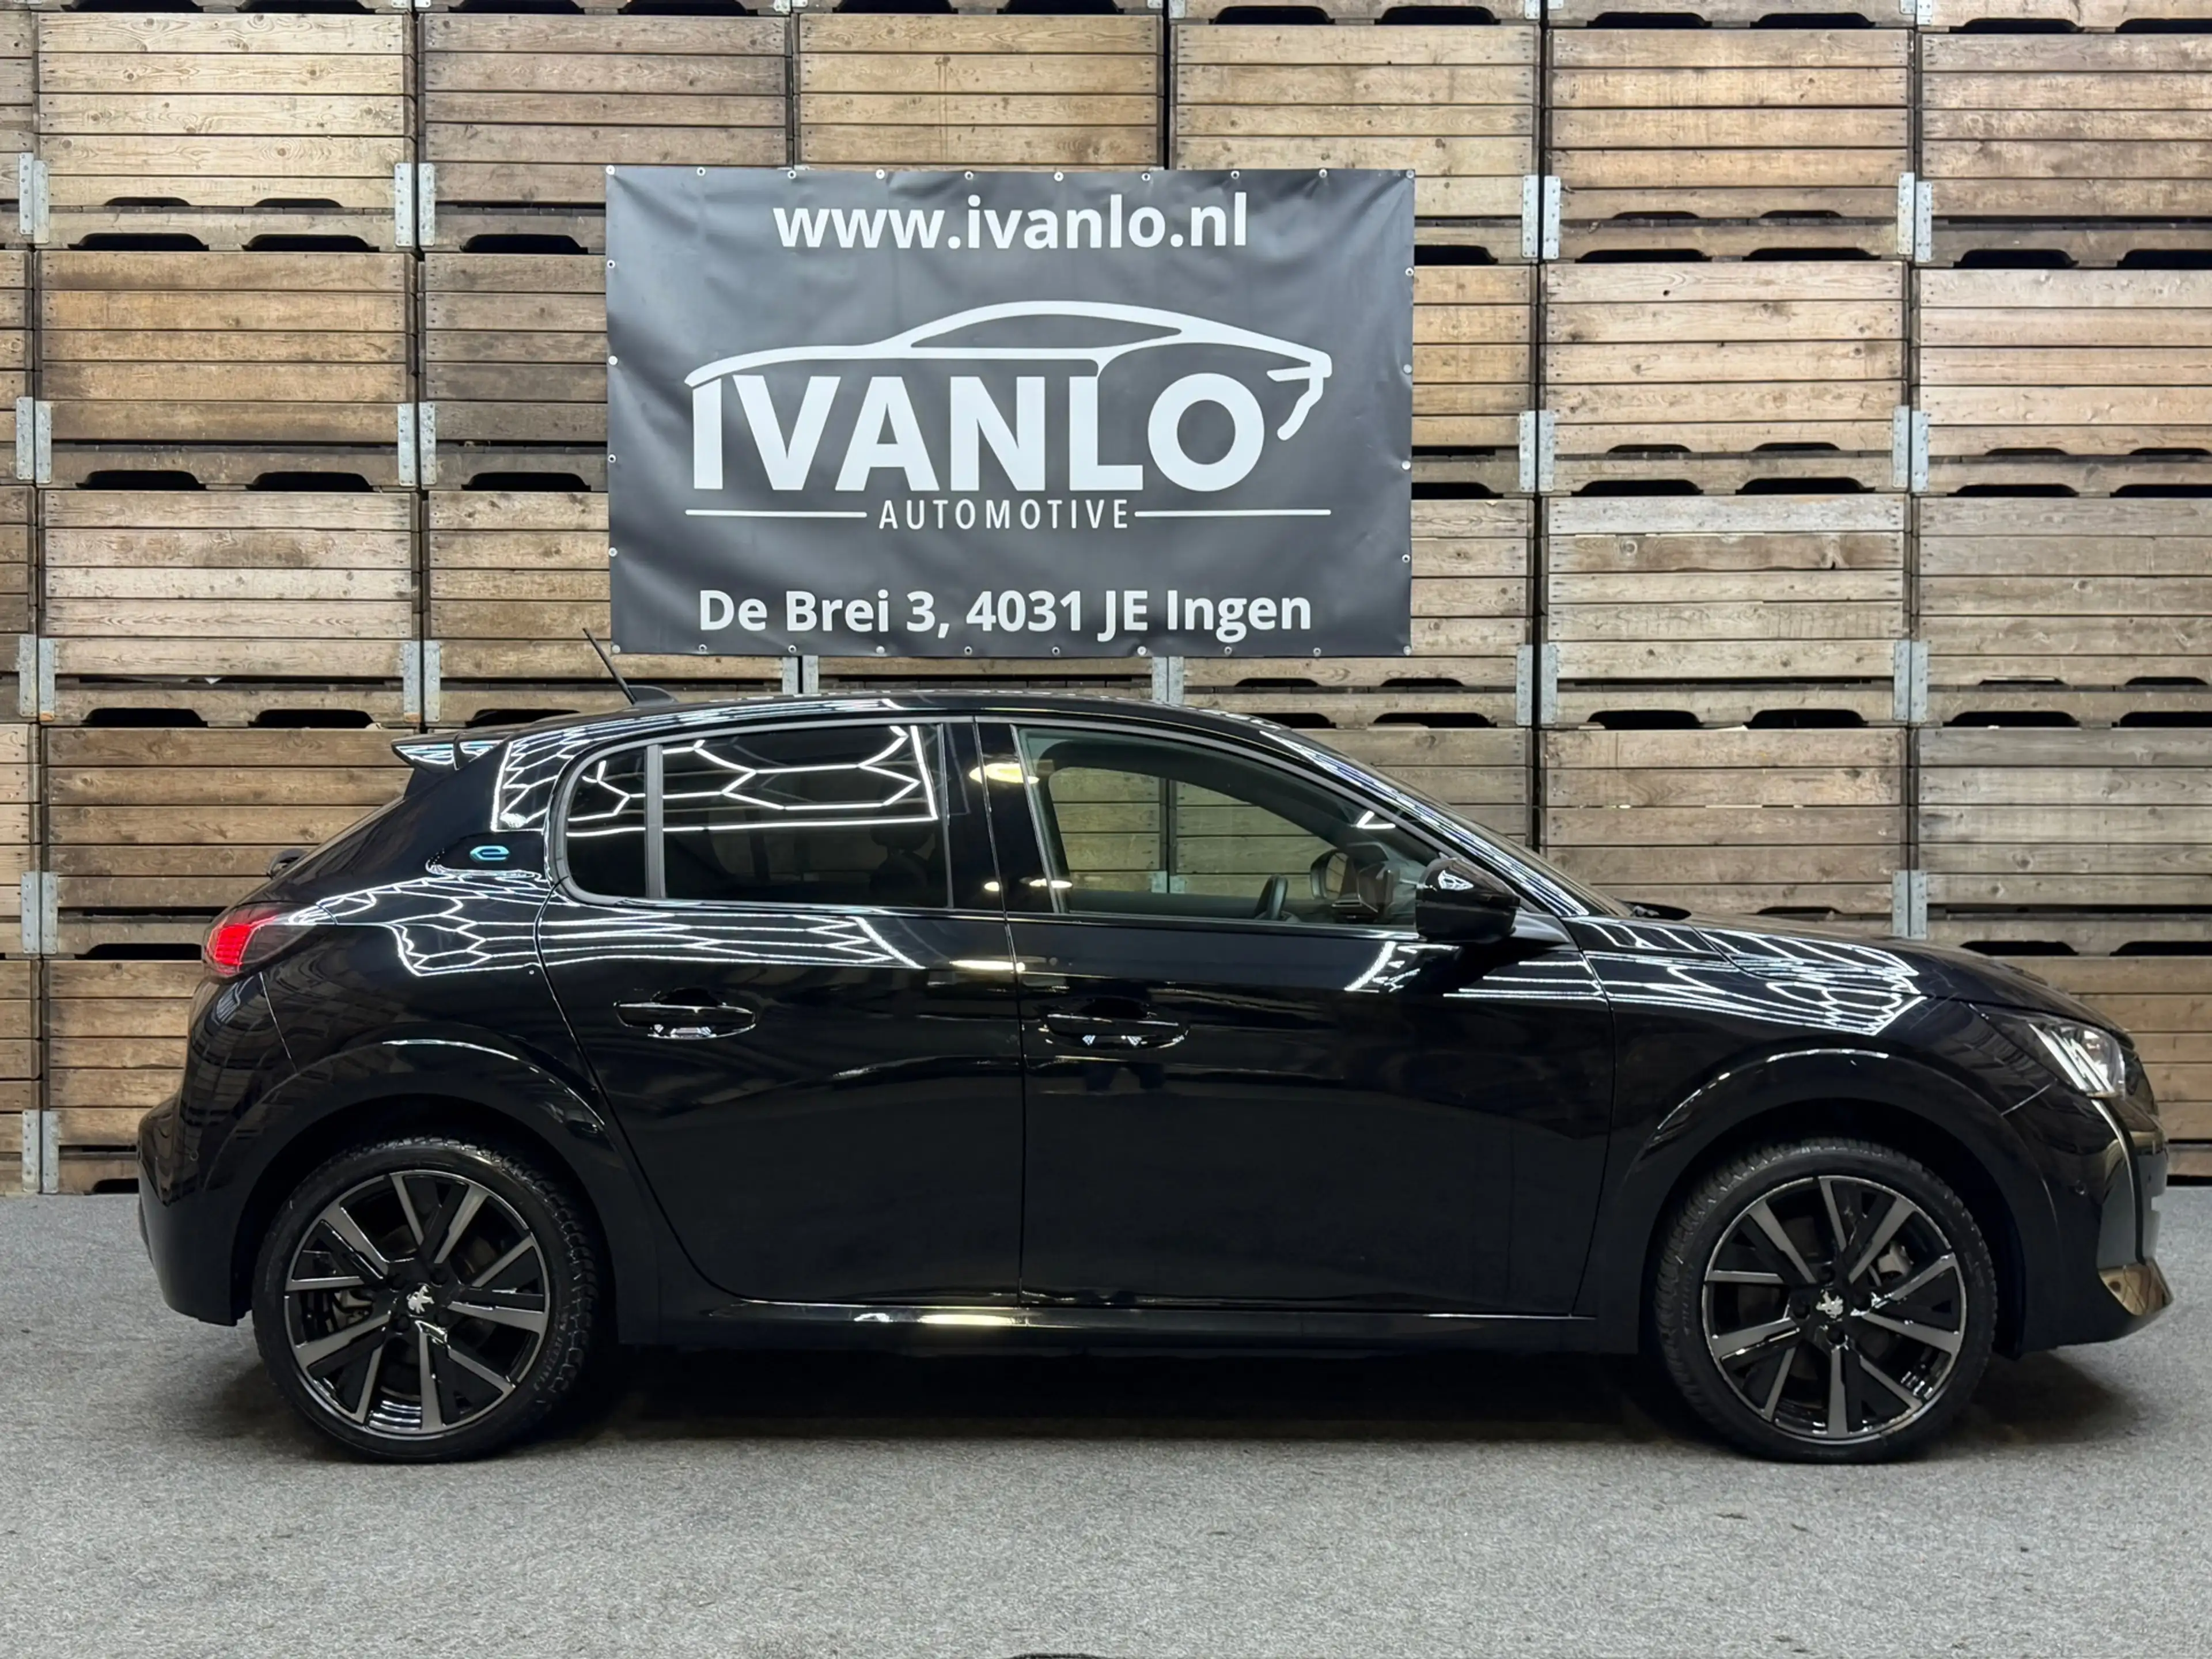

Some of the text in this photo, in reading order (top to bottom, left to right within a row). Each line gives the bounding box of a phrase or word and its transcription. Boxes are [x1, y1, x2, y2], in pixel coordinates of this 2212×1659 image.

[773, 192, 1247, 250] www.ivanlo.nl
[692, 373, 1264, 492] IVANLO
[879, 499, 1127, 530] AUTOMOTIVE
[700, 589, 1310, 643] De Brei 3, 4031 JE Ingen
